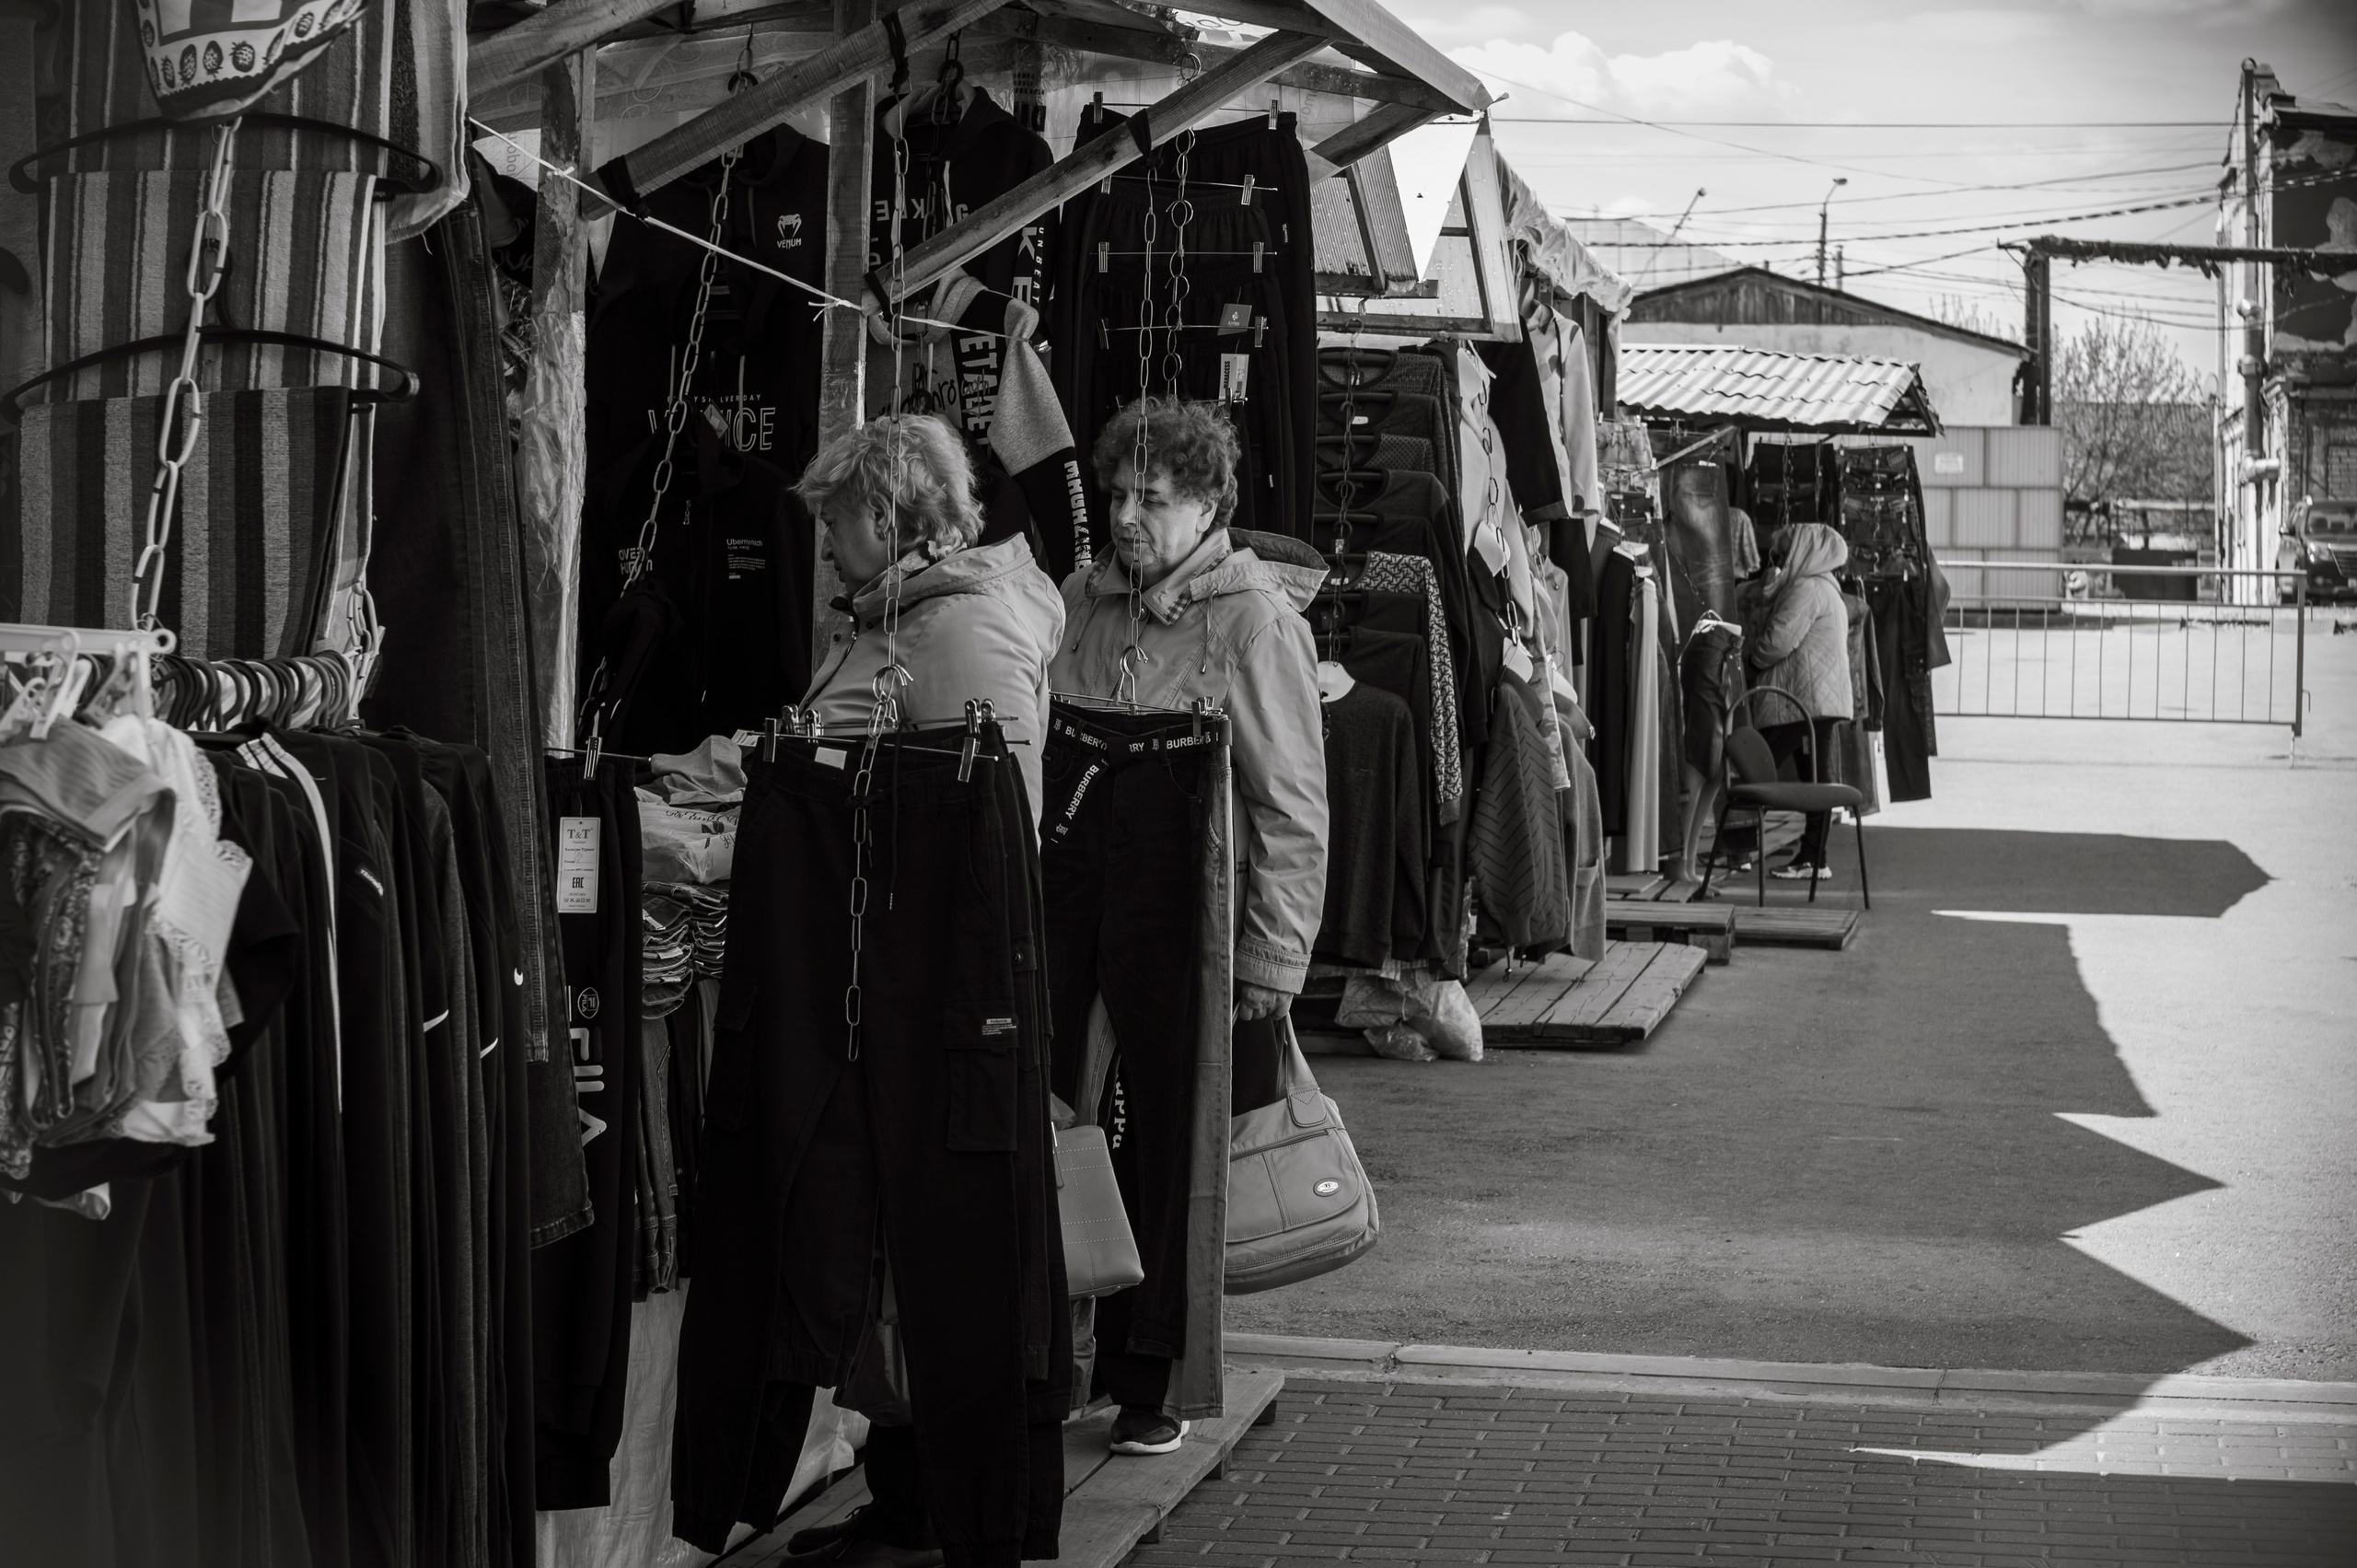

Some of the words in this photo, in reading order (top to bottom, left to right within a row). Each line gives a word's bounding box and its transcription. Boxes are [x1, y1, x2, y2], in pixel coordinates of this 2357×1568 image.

[777, 238, 801, 250] VENUM
[1065, 764, 1099, 820] BURBERRY
[566, 829, 590, 839] T&T
[572, 877, 584, 889] EAC
